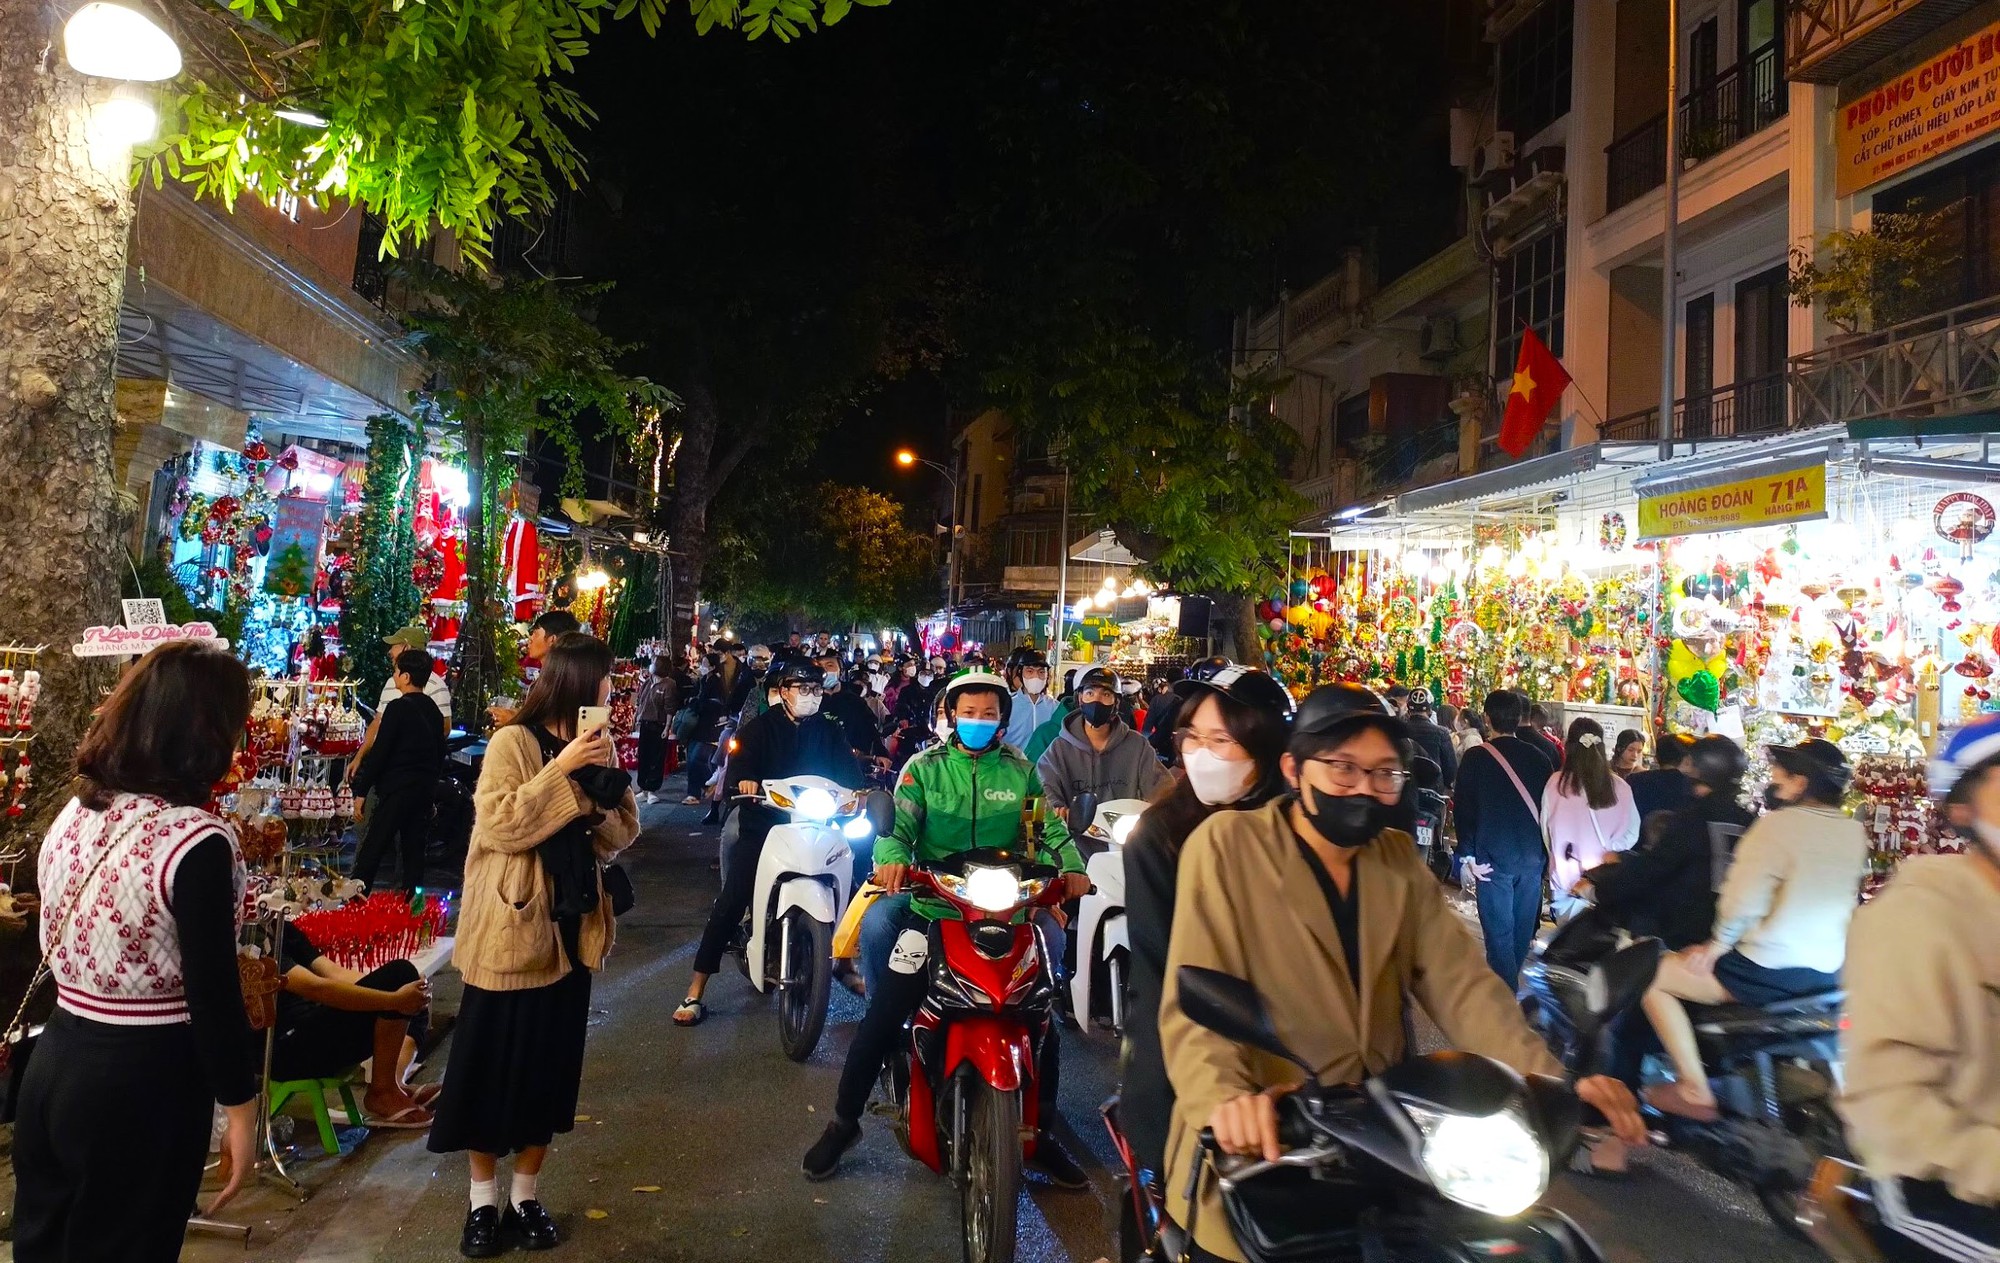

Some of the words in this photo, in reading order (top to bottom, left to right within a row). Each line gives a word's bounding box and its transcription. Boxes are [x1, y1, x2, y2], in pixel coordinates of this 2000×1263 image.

[1918, 43, 1974, 93] CƯỚI
[1888, 107, 1922, 131] FOMEX
[1932, 85, 1958, 110] GIẤY
[1960, 77, 1980, 97] KIM
[1873, 136, 1895, 156] CHỮ
[1768, 477, 1808, 503] 71A
[1659, 496, 1708, 519] HOÀNG
[1711, 488, 1753, 510] ĐOÀN
[1764, 502, 1793, 516] HÀNG
[1935, 494, 1960, 515] HAPPY
[1963, 494, 1994, 520] HOLIDAY
[99, 627, 140, 644] Love
[97, 641, 128, 652] HÀNG
[983, 788, 1017, 802] Grab
[979, 926, 1008, 934] HONDA
